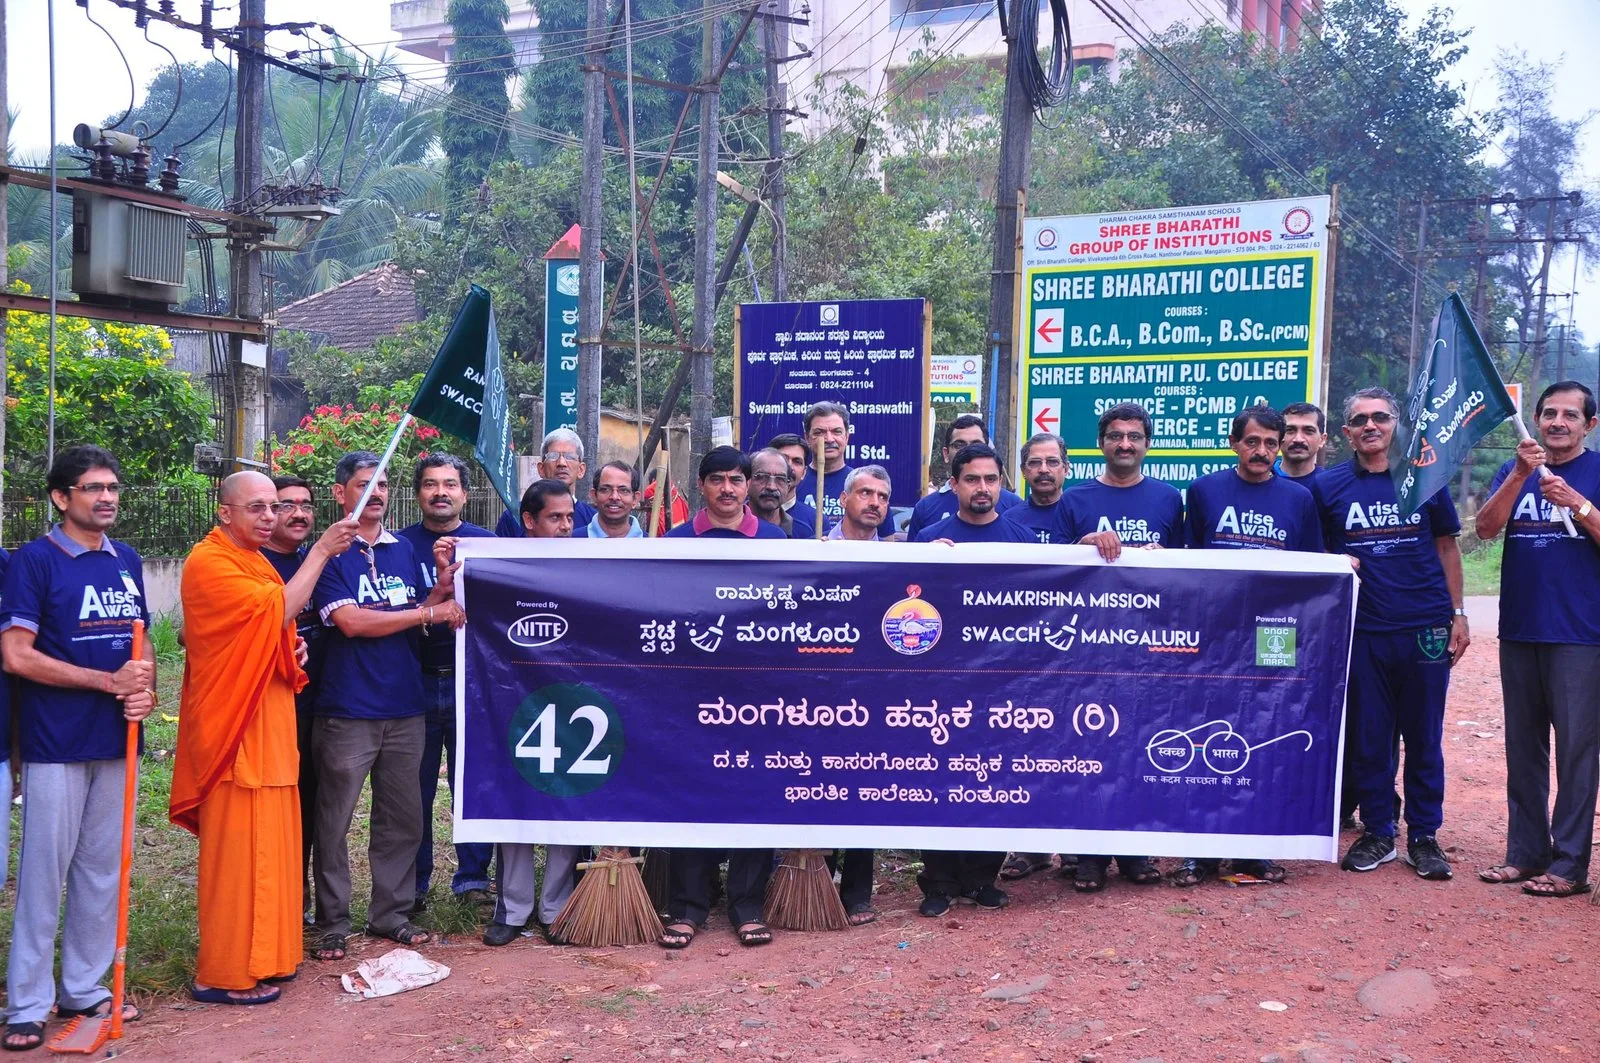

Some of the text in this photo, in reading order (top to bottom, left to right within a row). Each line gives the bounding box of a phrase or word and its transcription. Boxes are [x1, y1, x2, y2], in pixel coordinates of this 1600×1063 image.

[1099, 207, 1241, 224] DHARMA CHAKRA SAMSTHANAM SCHOOLS
[1099, 216, 1240, 238] SHREE BHARATHI
[1069, 240, 1124, 255] GROUP
[1128, 238, 1149, 251] OF
[1154, 230, 1272, 249] INSTITUTIONS
[1033, 264, 1305, 302] SHREE BHARATHI COLLEGE
[1164, 306, 1203, 317] COURSES
[1071, 324, 1132, 349] B.C.A.,
[1139, 321, 1212, 346] B.Com.,
[864, 367, 870, 376] 4
[1032, 360, 1299, 385] SHREE BHARATHI P.U. COLLEGE
[820, 380, 874, 390] 0824-2211104
[1154, 385, 1197, 396] COURSES
[748, 401, 784, 415] Swami
[849, 401, 913, 415] Saraswathi
[1094, 397, 1166, 416] SCCE
[1184, 396, 1236, 415] PCMB
[1435, 390, 1485, 444] ಮಂಗಳೂರು
[860, 444, 890, 460] Std.
[516, 600, 559, 609] Powered By
[715, 584, 861, 609] ರಾಮಕೃಷ್ಣ ಮಿಷನ್
[962, 589, 1161, 609] RAMAKRISHNA MISSION
[517, 621, 562, 638] NITTE
[1255, 615, 1298, 624] Powered By
[736, 622, 861, 645] ಮಂಗಳೂರು
[961, 624, 1200, 648] SWACCH MANGALURU
[1263, 658, 1289, 666] MRPL
[697, 696, 1121, 746] ಮಂಗಳೂರು ಹವ್ಯಕ ಸಭಾ (ರಿ)
[515, 703, 611, 775] 42
[1157, 747, 1239, 759] स्वच्छ भारत
[713, 750, 1103, 782] ದ.ಕ. ಮತ್ತು ಕಾಸರಗೋಡು ಹವ್ಯಕ ಮಹಾಸಭಾ
[1143, 775, 1251, 787] एक कदम स्वच्छता की ओर
[784, 783, 1031, 805] ಭಾರತೀ ಕಾಲೇಜು, ನಂತೂರು
